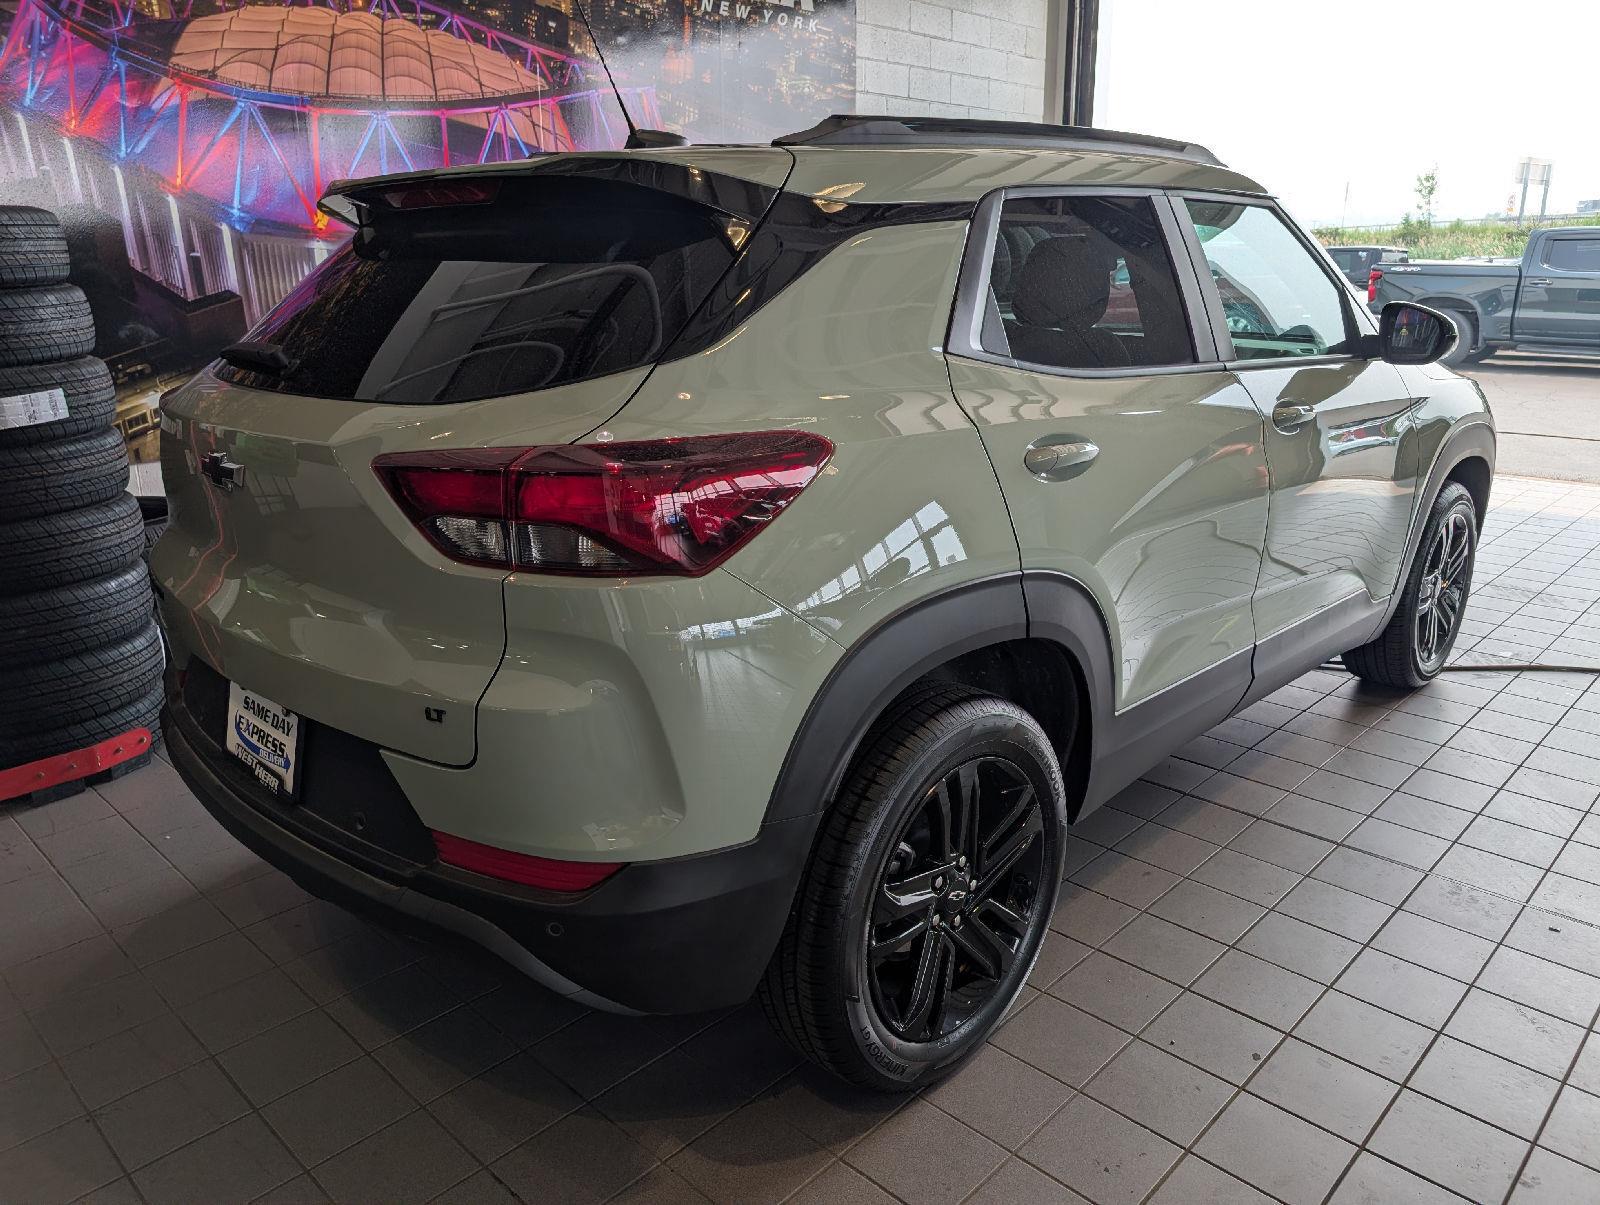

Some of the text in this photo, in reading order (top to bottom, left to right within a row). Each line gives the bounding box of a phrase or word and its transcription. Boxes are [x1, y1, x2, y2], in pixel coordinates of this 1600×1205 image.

[700, 0, 752, 20] NEW
[763, 9, 819, 32] YORK
[242, 695, 294, 737] SAME DAY
[424, 706, 447, 723] LT
[238, 715, 287, 758] EXPRESS
[234, 742, 259, 769] WEST
[259, 748, 286, 768] DELIVERY
